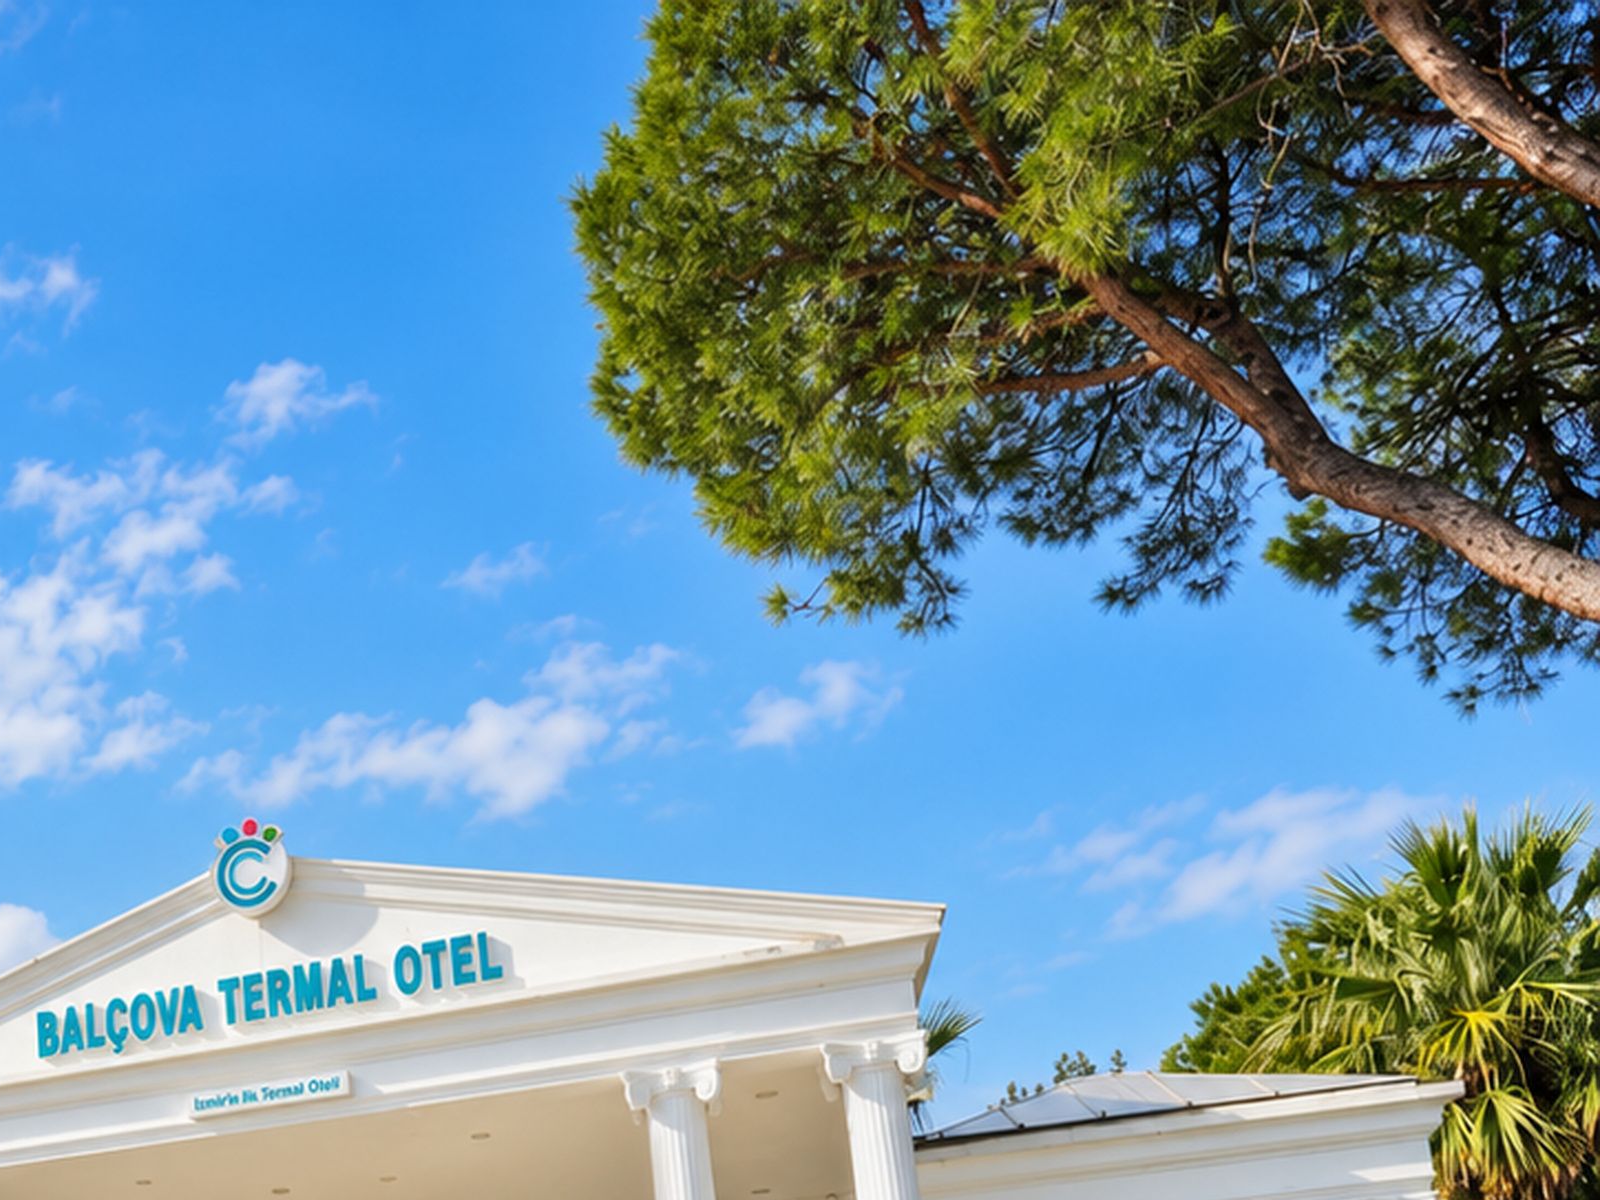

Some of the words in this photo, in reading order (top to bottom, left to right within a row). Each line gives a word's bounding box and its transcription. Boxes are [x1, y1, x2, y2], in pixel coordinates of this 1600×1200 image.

[36, 984, 204, 1058] BALÇOVA
[217, 954, 378, 1025] TERMAL
[393, 931, 504, 996] OTEL
[261, 1082, 305, 1101] Termal
